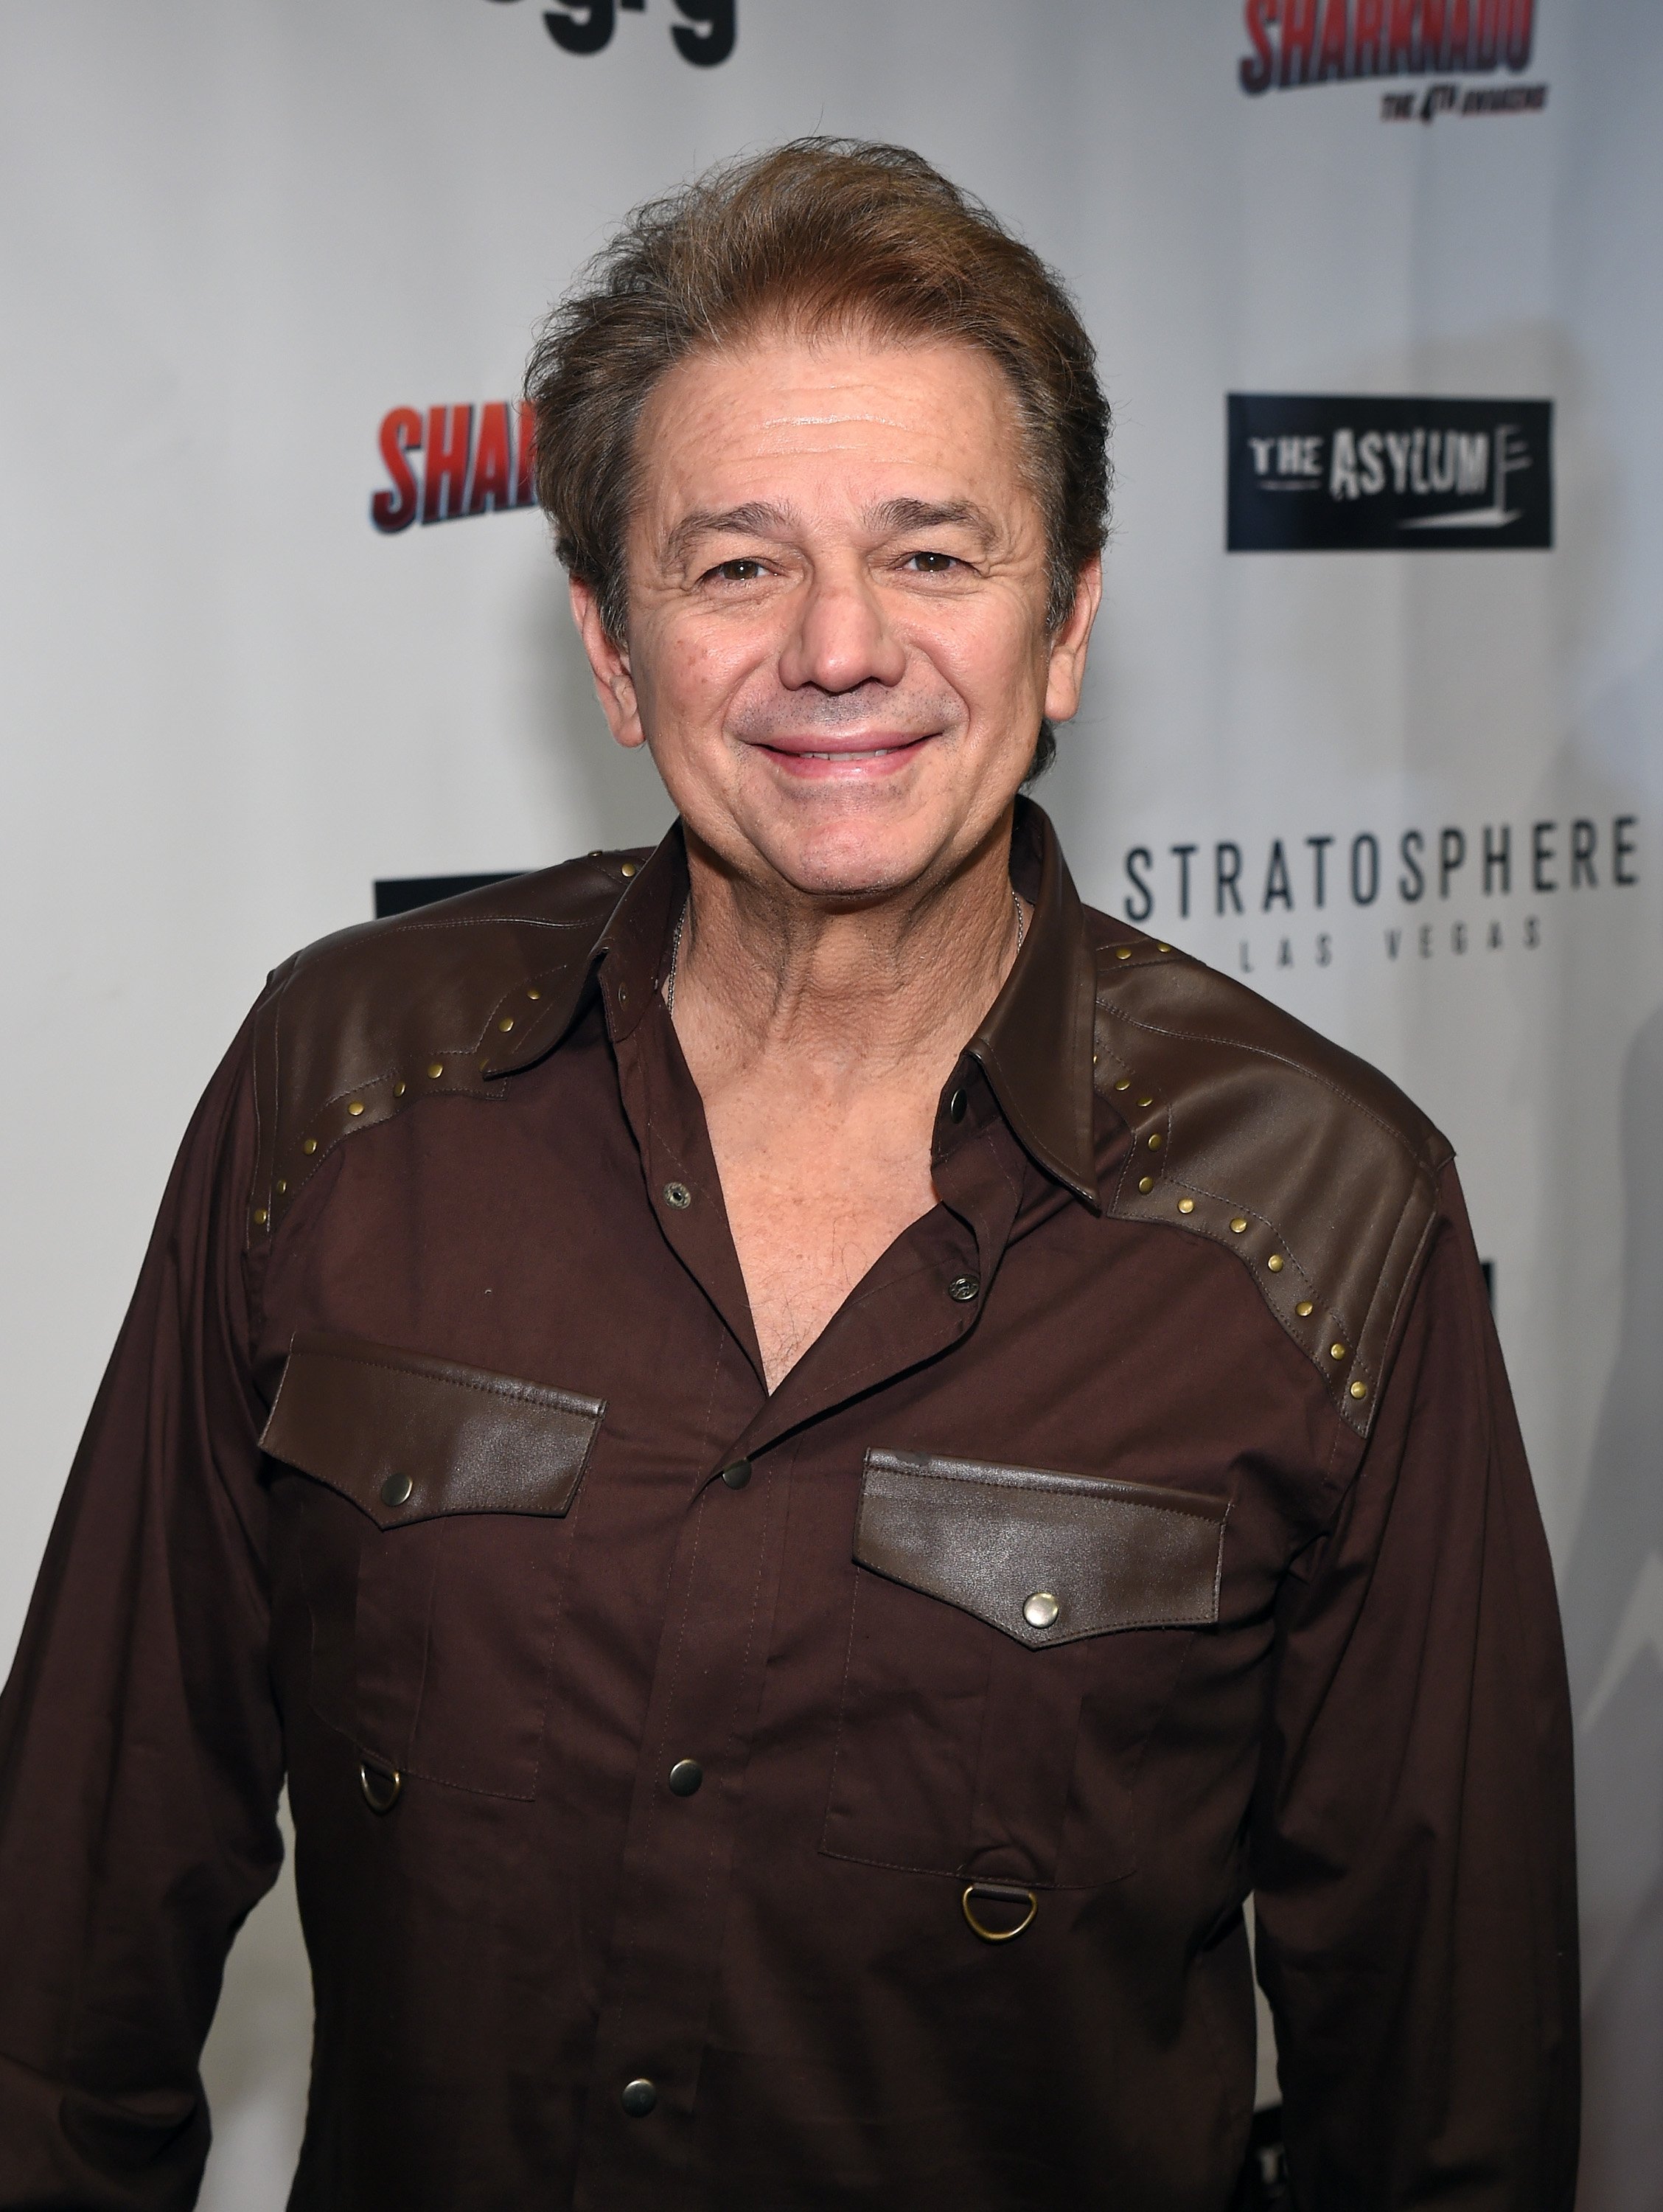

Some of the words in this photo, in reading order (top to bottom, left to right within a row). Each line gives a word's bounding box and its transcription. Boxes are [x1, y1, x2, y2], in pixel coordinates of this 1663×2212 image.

[1249, 437, 1322, 476] THE
[1330, 428, 1488, 501] ASYLUM
[1123, 814, 1639, 923] STRATOSPHERE
[1238, 933, 1333, 973] LAS
[1385, 914, 1542, 961] VEGAS
